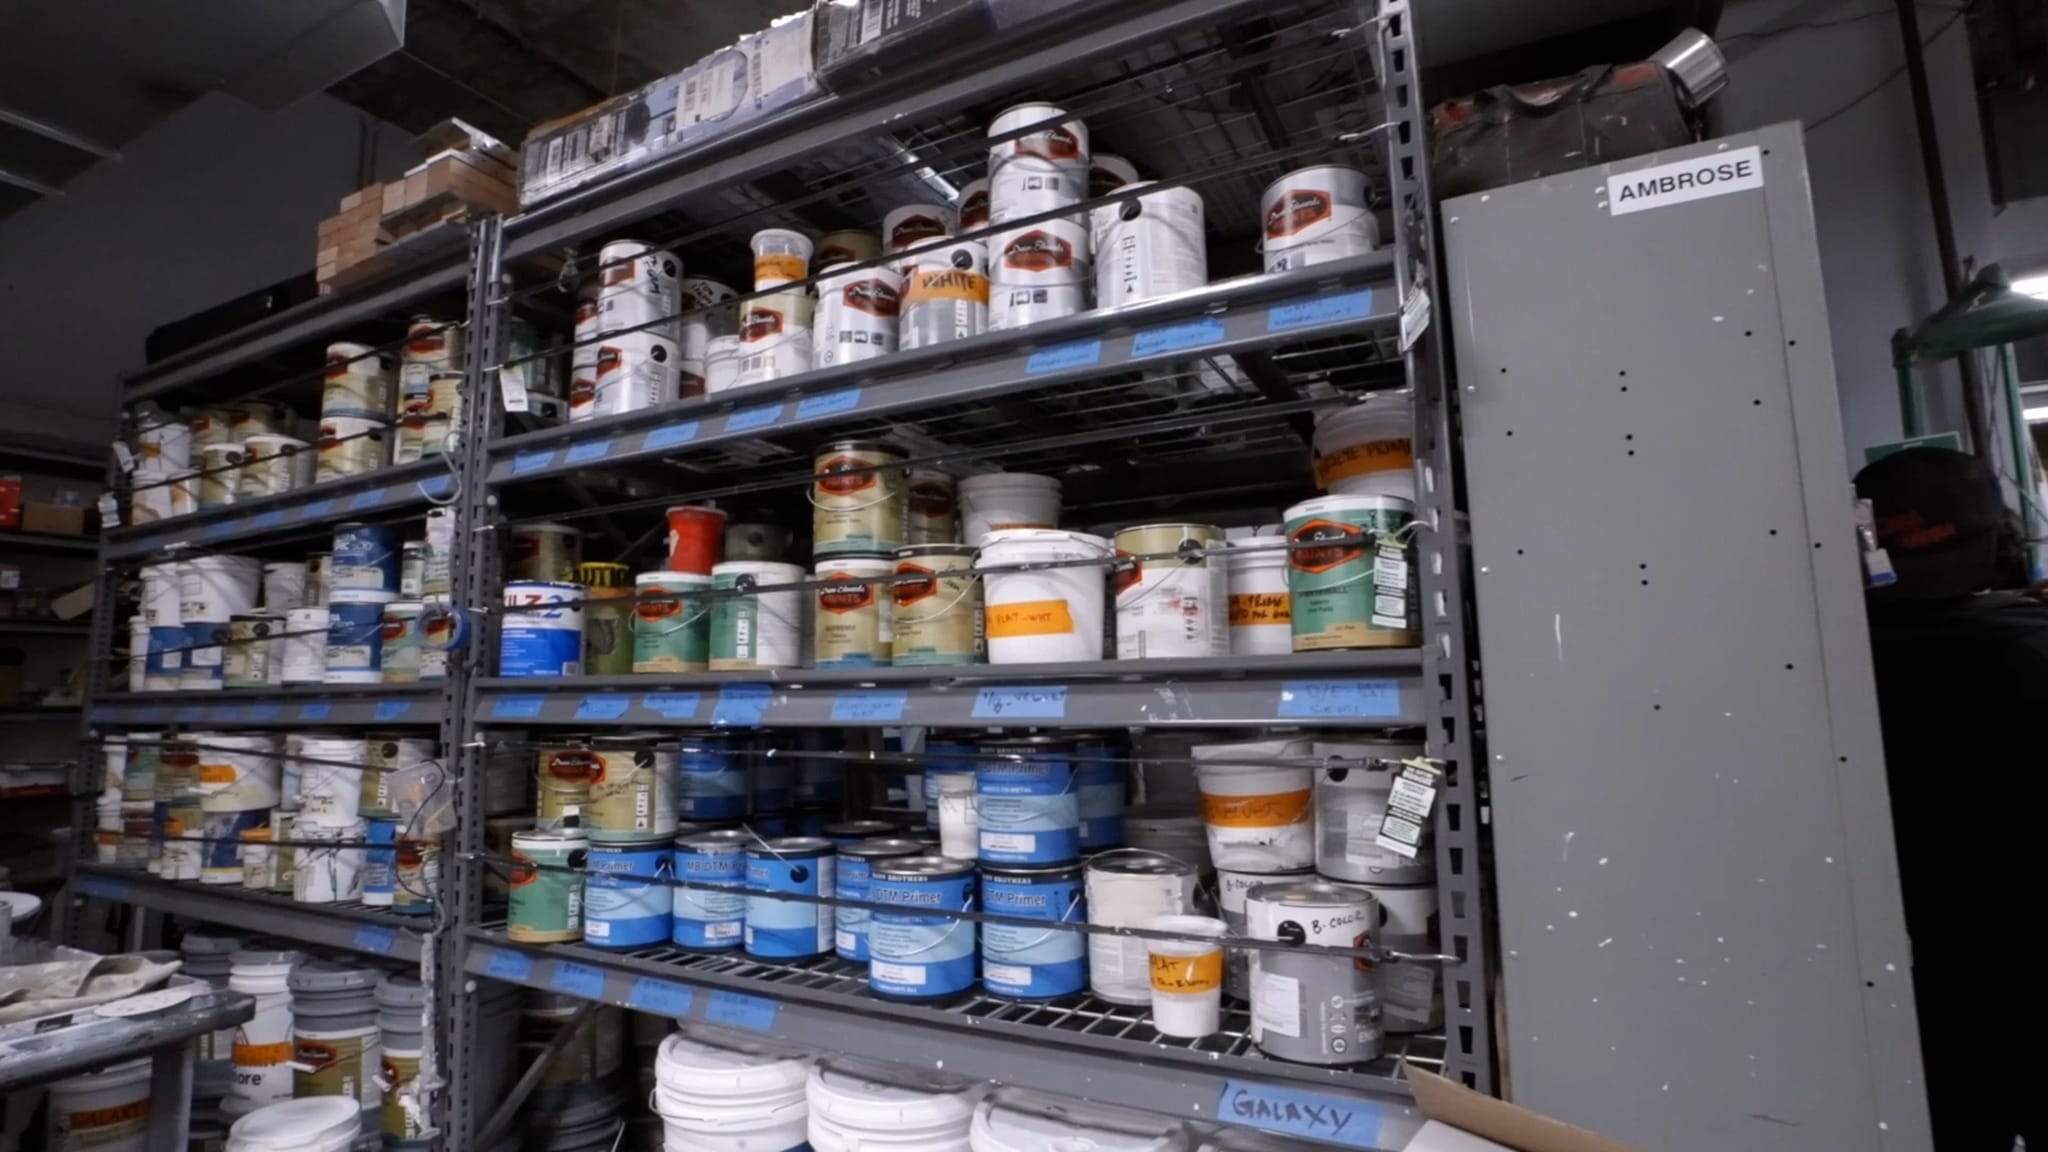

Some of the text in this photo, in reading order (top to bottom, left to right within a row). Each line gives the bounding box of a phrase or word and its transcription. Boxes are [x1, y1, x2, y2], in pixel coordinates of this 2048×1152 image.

[1619, 160, 1752, 202] AMBROSE
[922, 271, 976, 291] WHITE
[902, 890, 941, 905] Primer
[1006, 892, 1047, 907] Primer
[1232, 1088, 1353, 1137] GALAXY
